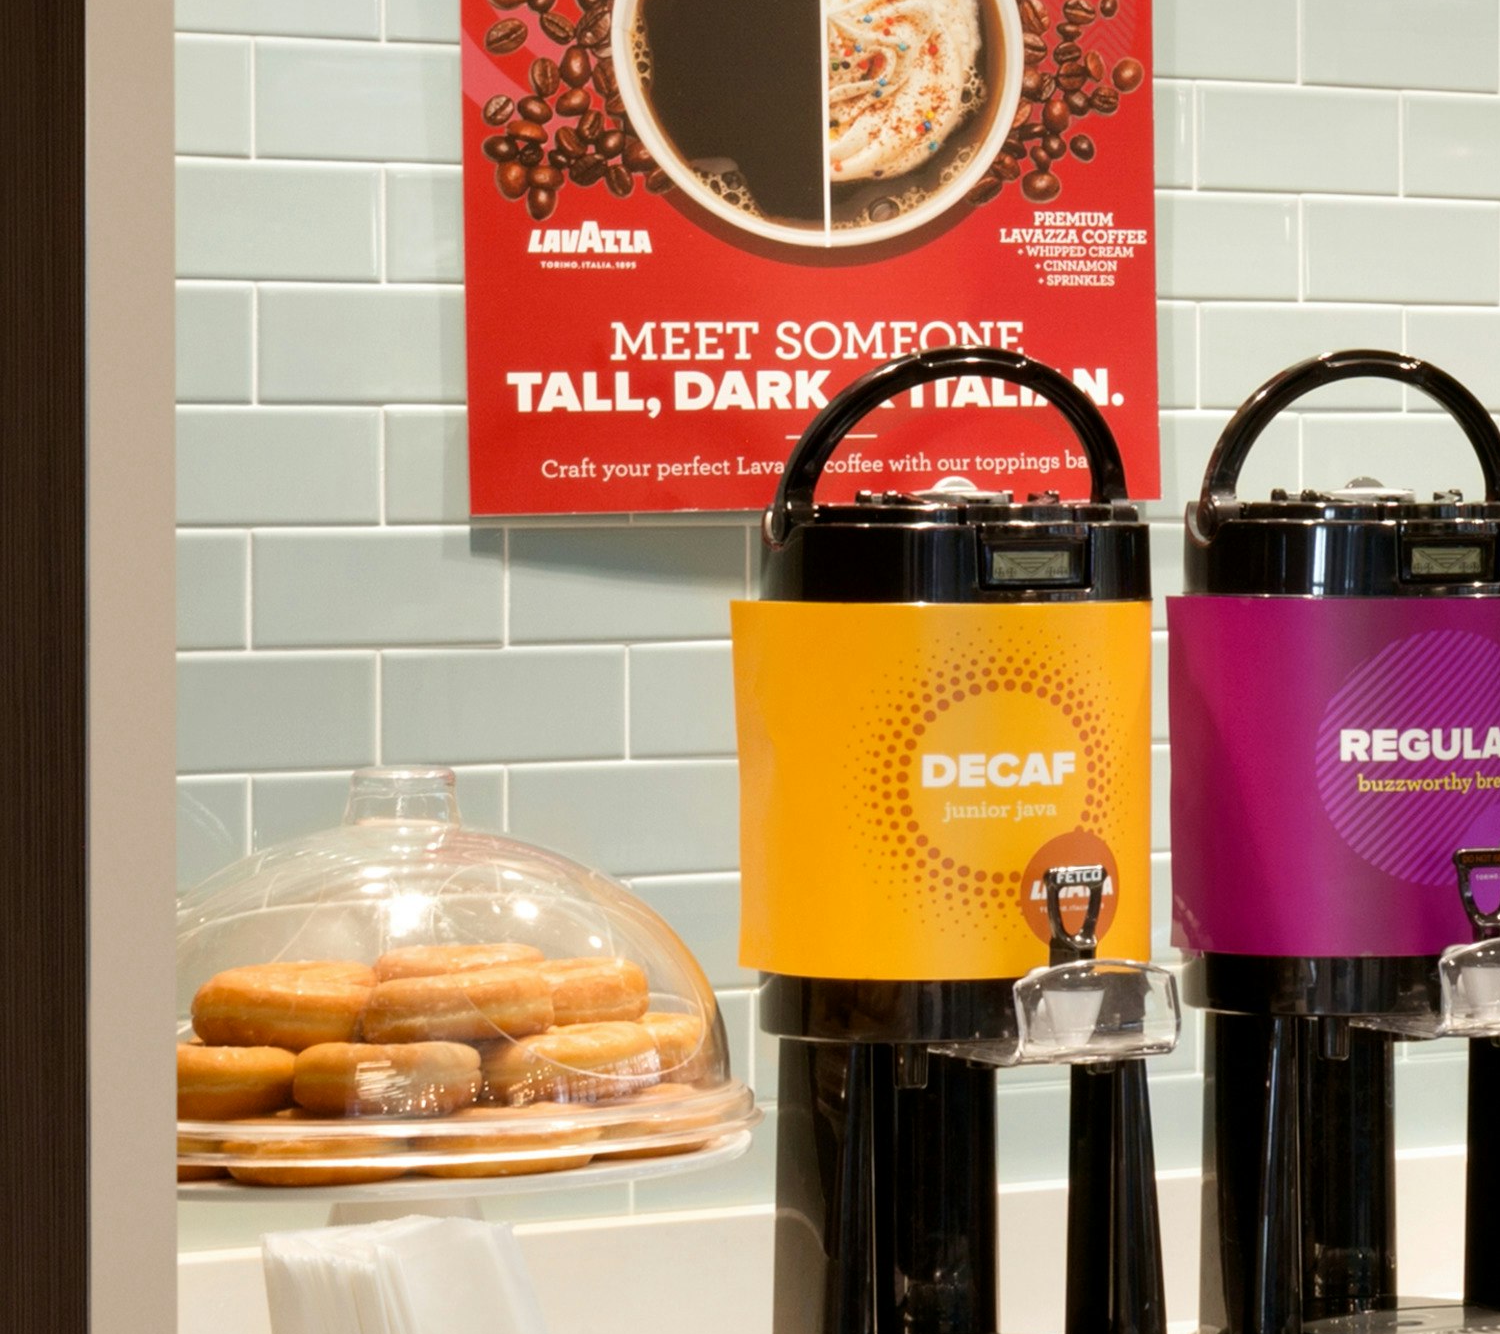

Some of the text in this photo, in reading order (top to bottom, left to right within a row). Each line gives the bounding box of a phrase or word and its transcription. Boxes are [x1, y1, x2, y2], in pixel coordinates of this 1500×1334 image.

[1033, 211, 1114, 227] PREMIUM
[527, 220, 653, 254] LAVAZZA
[999, 228, 1148, 245] LAVAZZA COFFEE
[1025, 246, 1087, 258] WHIPPED
[1088, 246, 1134, 258] CREAM
[1043, 260, 1118, 272] CINNAMON
[1046, 274, 1115, 287] SPRINKLES
[609, 320, 1025, 361] MEET SOMEONE
[506, 371, 662, 419] TALL,
[673, 370, 832, 411] DARK
[541, 450, 1089, 482] Craft your perfect Lava coffee with our toppings ba
[921, 751, 1076, 788] DECAF
[1356, 771, 1473, 794] buzzworthy
[942, 800, 1057, 823] junior java
[1056, 869, 1103, 884] FETCO
